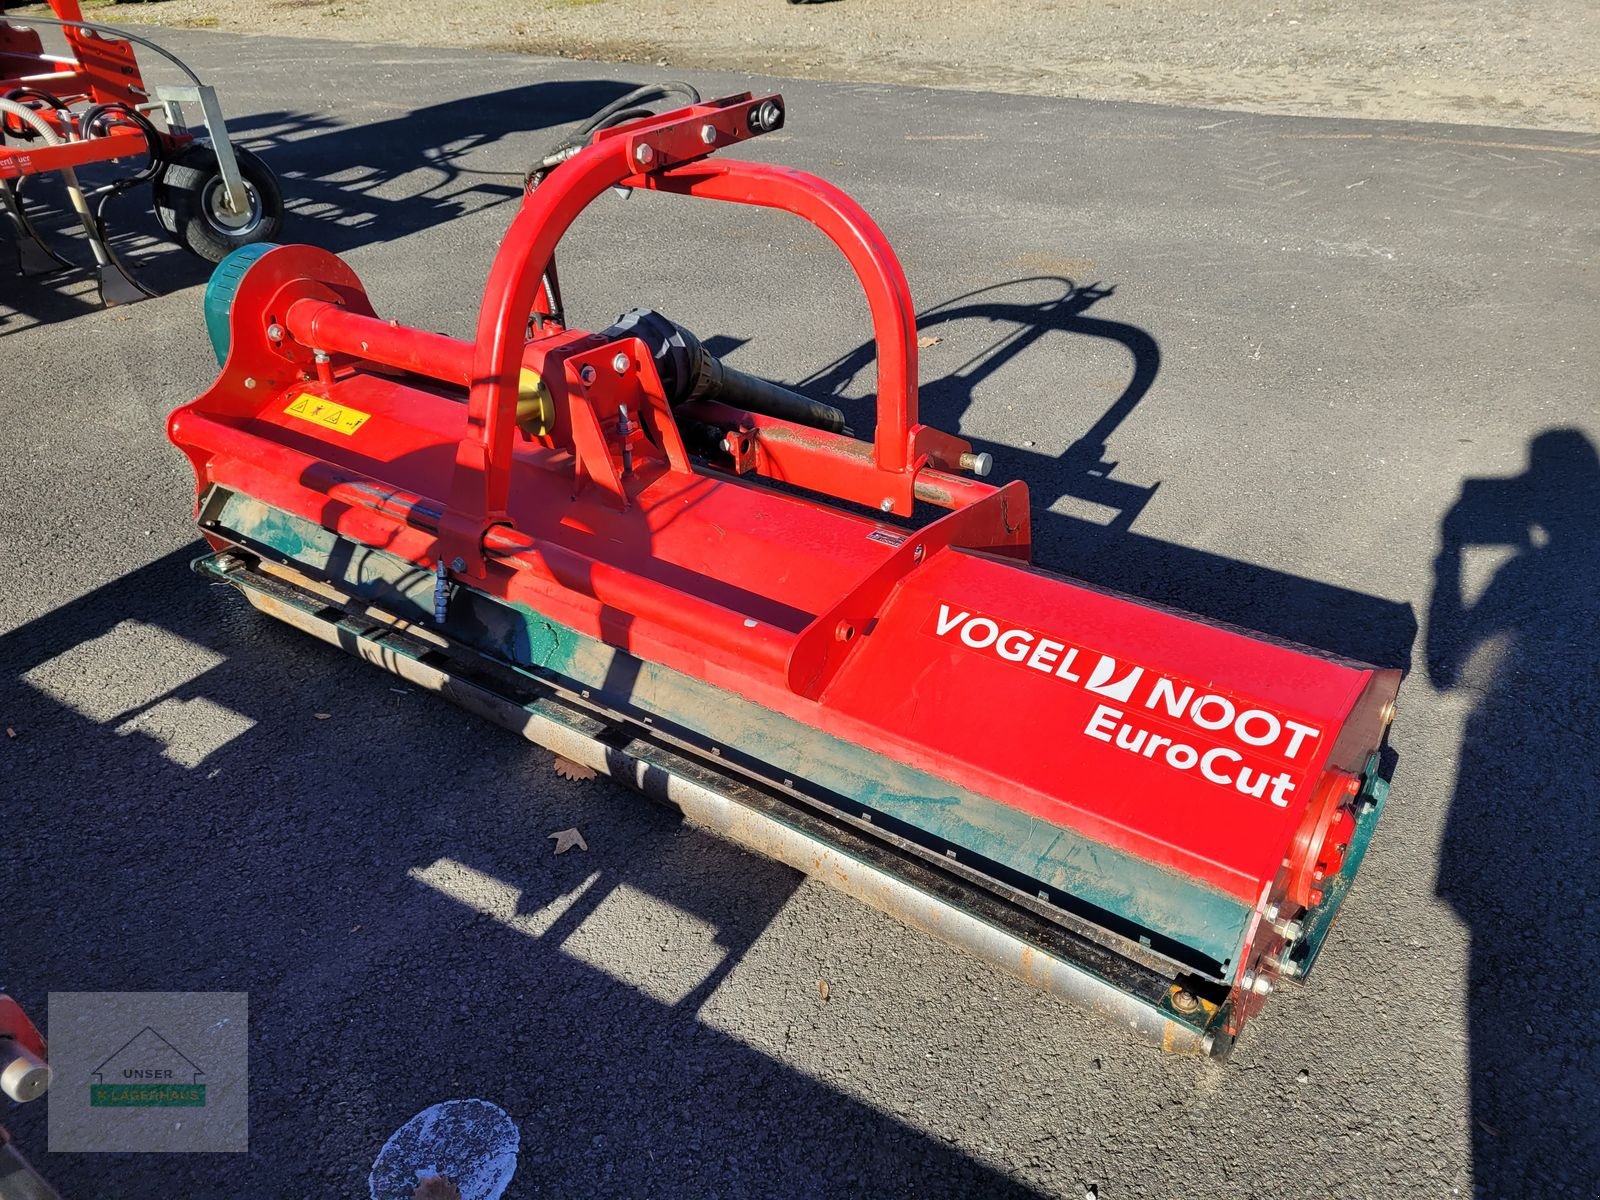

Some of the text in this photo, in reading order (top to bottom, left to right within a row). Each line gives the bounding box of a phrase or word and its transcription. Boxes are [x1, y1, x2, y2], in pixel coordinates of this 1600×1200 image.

[936, 604, 1320, 759] VOGEL NOOT
[1083, 704, 1296, 808] EuroCut
